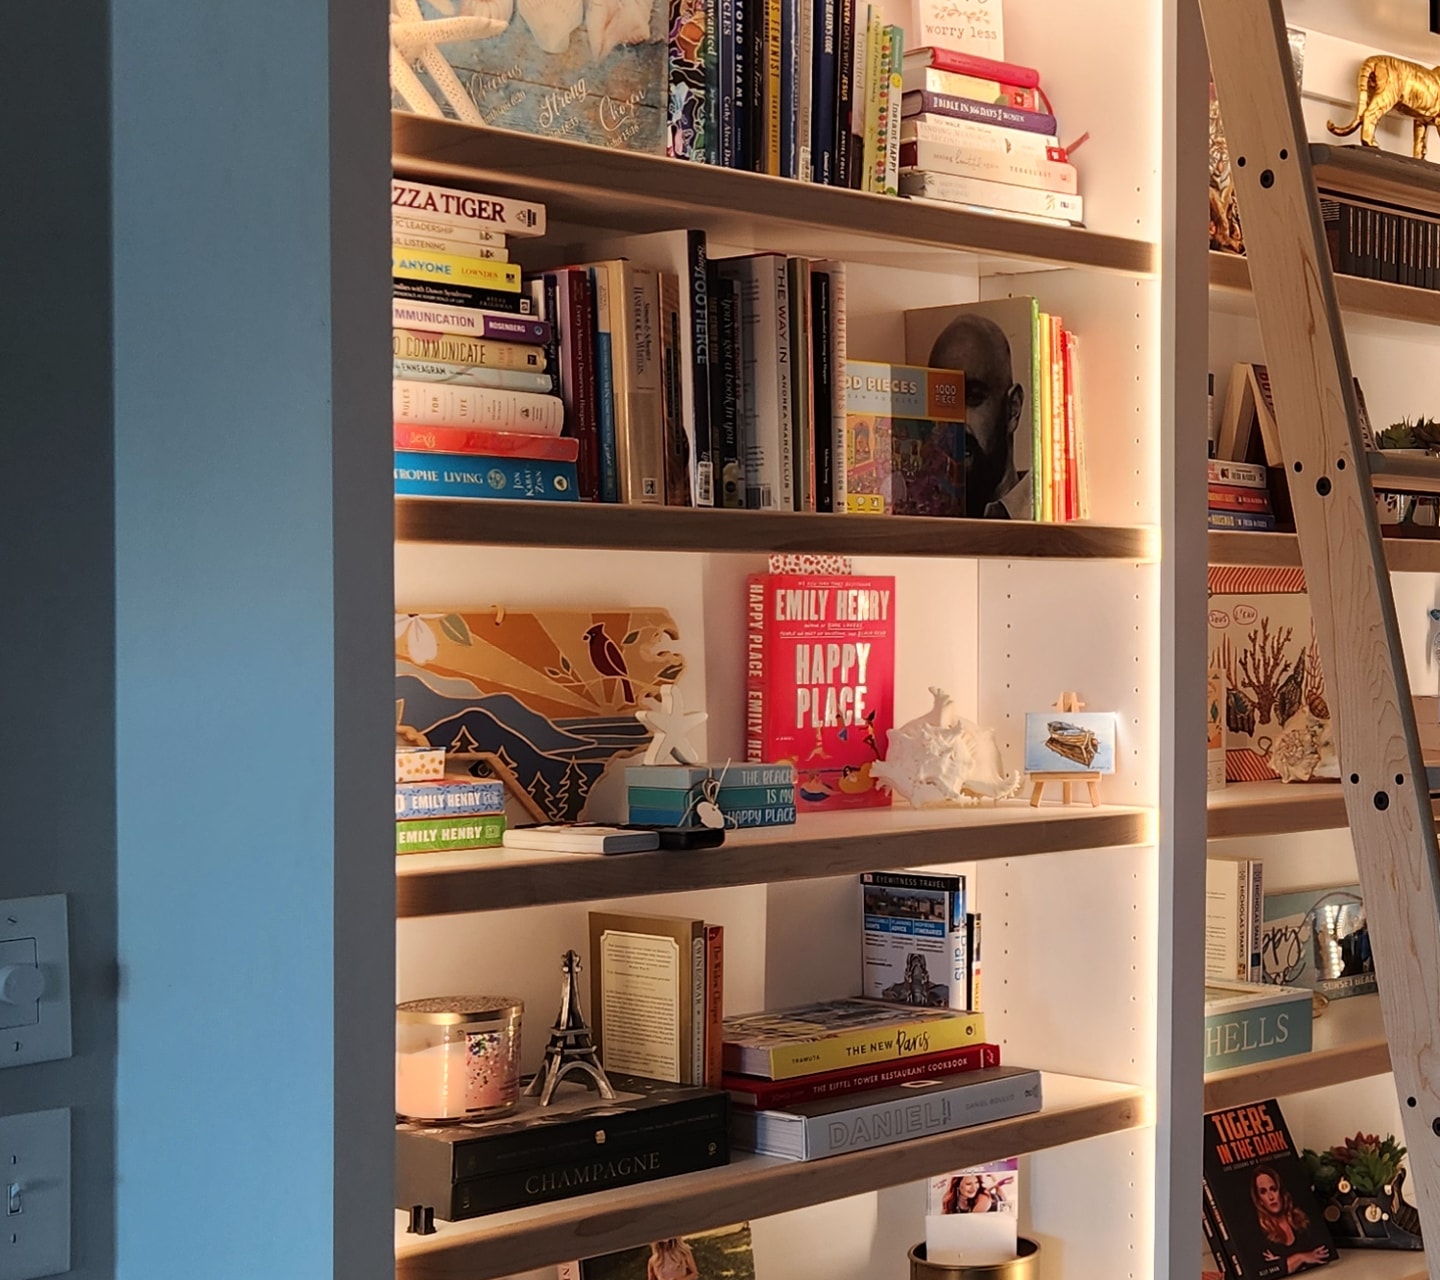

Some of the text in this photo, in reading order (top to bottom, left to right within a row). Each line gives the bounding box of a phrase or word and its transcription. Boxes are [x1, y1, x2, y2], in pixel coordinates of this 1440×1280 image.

[926, 24, 997, 40] worry less
[771, 19, 780, 79] FEMINIST
[841, 74, 849, 101] JESUS
[888, 102, 899, 173] Instant HAPPY
[441, 194, 507, 223] TIGER
[399, 259, 452, 276] ANYONE
[777, 265, 786, 341] THE WAY
[406, 336, 486, 364] COMMUNICATE
[696, 309, 707, 364] FIERCE
[443, 470, 483, 485] LIVING
[775, 589, 890, 622] EMILY HENRY
[748, 584, 763, 736] HAPPY PLACE EMILY
[795, 643, 872, 686] HAPPY
[796, 686, 867, 729] PLACE
[741, 770, 760, 786] THE
[412, 792, 480, 810] EMILY HENRY
[765, 807, 796, 824] PLACE
[400, 826, 482, 844] EMILY HENRY
[876, 875, 917, 887] EYEWITNESS
[846, 1030, 931, 1057] THE NEW Paris
[853, 1058, 968, 1086] TOWER RESTAURANT COOKBOOK
[828, 1103, 941, 1150] DANIEL
[1211, 1104, 1275, 1143] TIGERS
[1216, 1130, 1289, 1164] IN THE DARK
[525, 1152, 662, 1195] CHAMPAGNE
